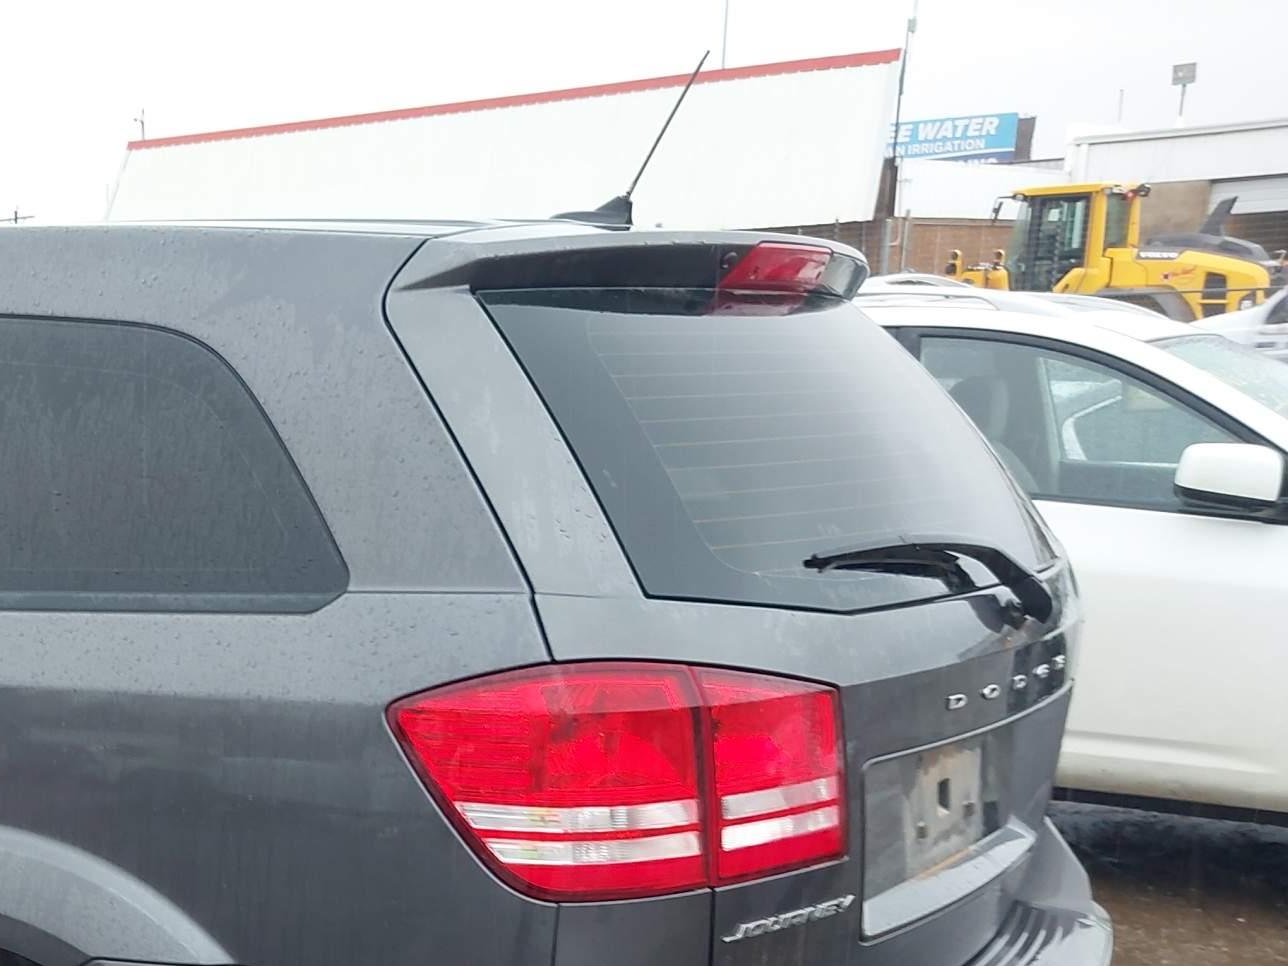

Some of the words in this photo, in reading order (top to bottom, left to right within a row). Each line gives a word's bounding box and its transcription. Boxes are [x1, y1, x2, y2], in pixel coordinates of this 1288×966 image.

[907, 138, 986, 155] IRRIGATION
[917, 116, 1000, 141] WATER
[947, 654, 1066, 710] DODGE
[721, 894, 856, 943] JOURNEY
